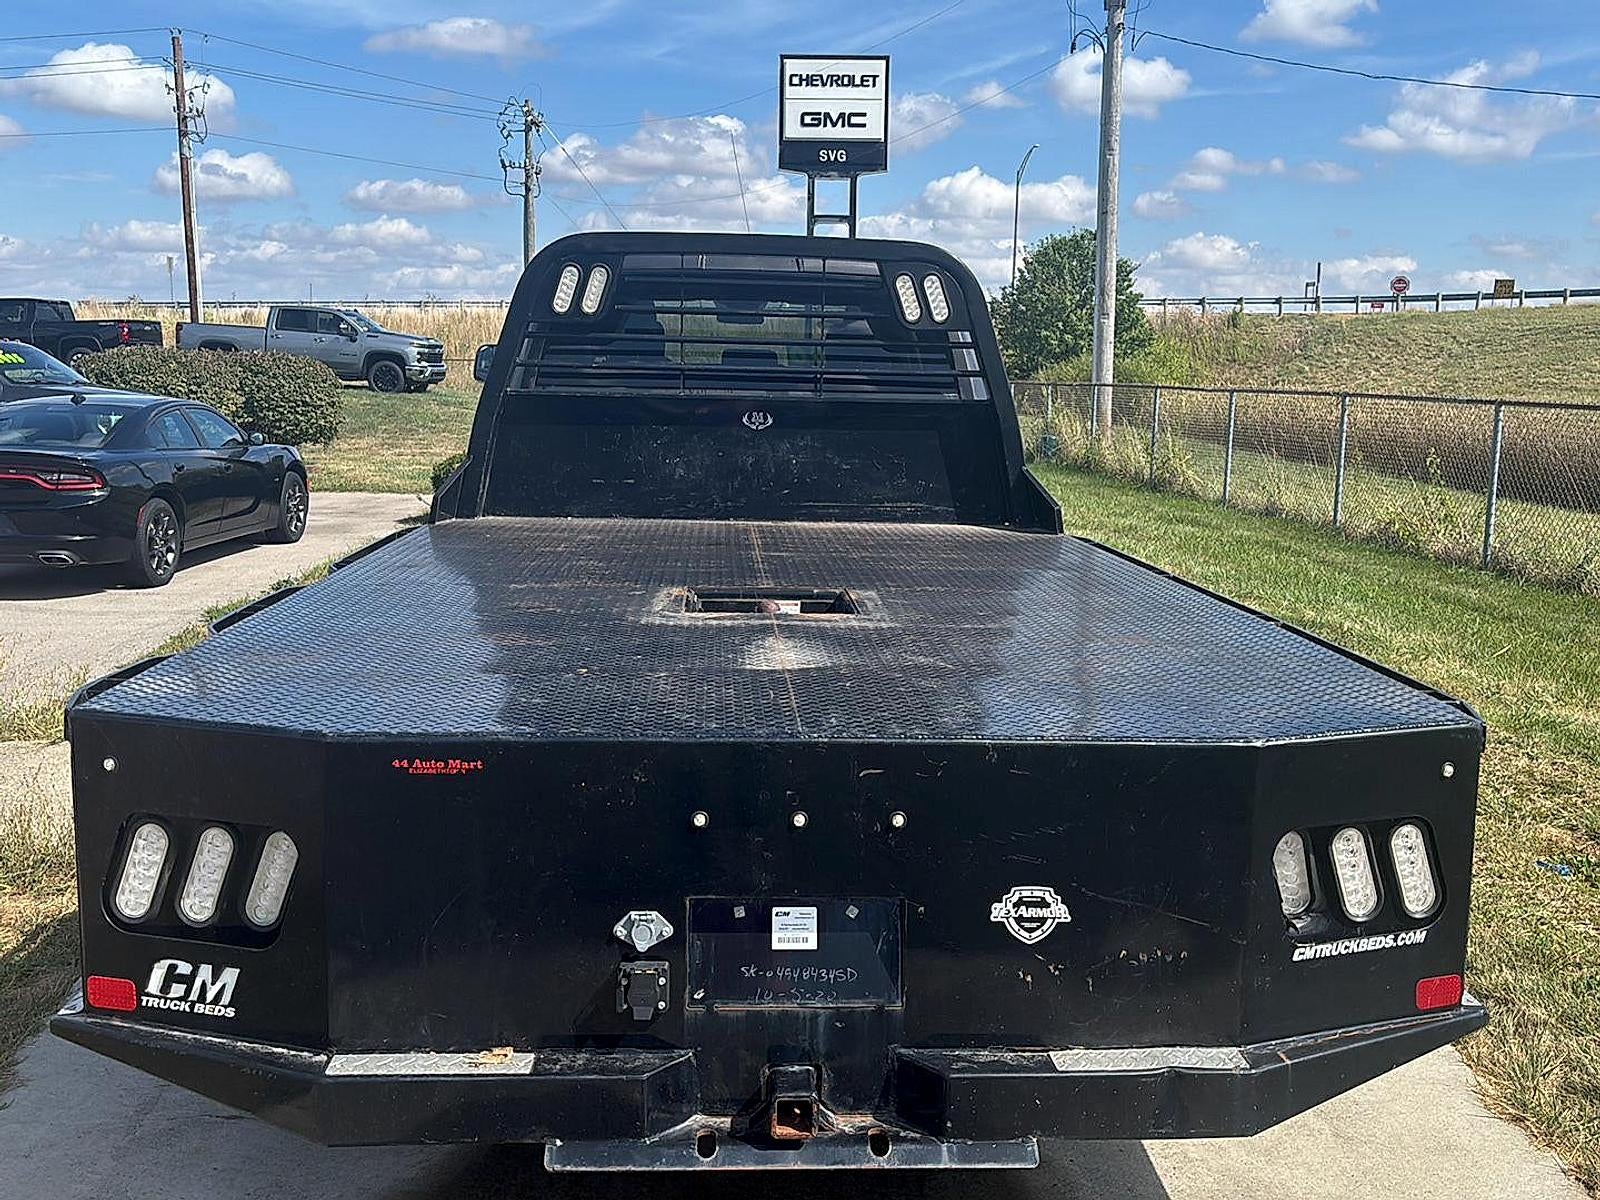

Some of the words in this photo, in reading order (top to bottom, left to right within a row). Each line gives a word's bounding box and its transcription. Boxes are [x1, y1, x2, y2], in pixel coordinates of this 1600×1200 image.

[788, 73, 880, 88] CHEVROLET
[800, 111, 867, 128] GMC
[819, 149, 847, 162] SVG
[391, 759, 409, 768] 44
[412, 758, 445, 768] Auto
[448, 759, 484, 769] Mart
[1292, 930, 1427, 961] CMTRUCKBEDS.COM
[144, 958, 241, 1006] CM
[140, 996, 191, 1013] TRUCK
[194, 1002, 236, 1018] BEDS
